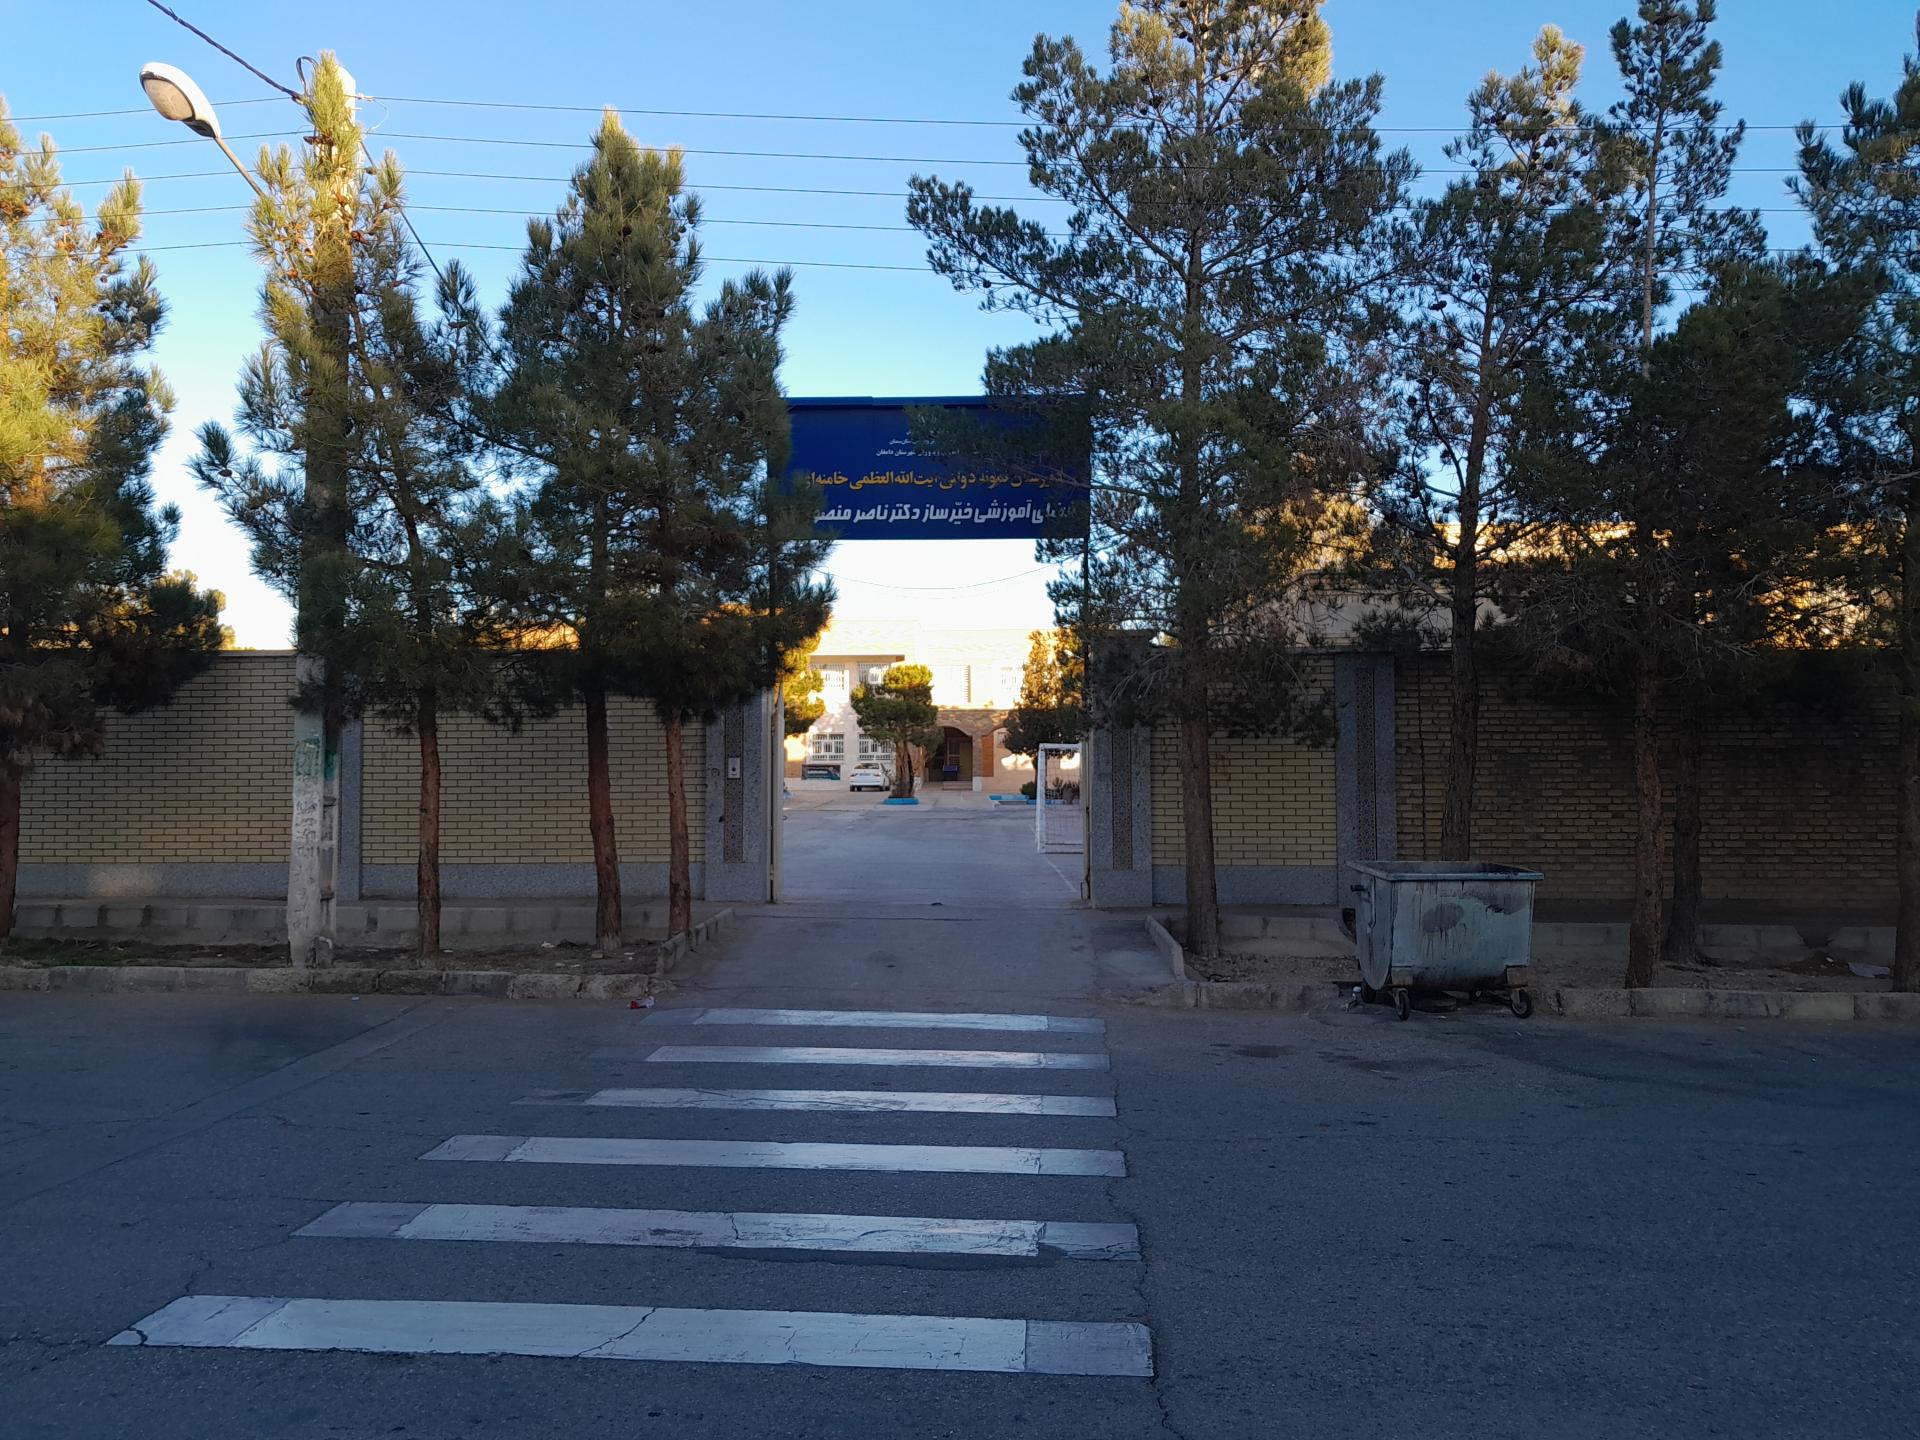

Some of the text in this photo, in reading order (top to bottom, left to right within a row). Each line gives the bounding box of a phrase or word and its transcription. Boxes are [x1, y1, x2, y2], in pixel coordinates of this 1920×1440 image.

[850, 470, 894, 490] العظمی
[853, 504, 888, 524] ناصر
[888, 503, 920, 523] دکتر
[974, 499, 1032, 524] آموزشی
